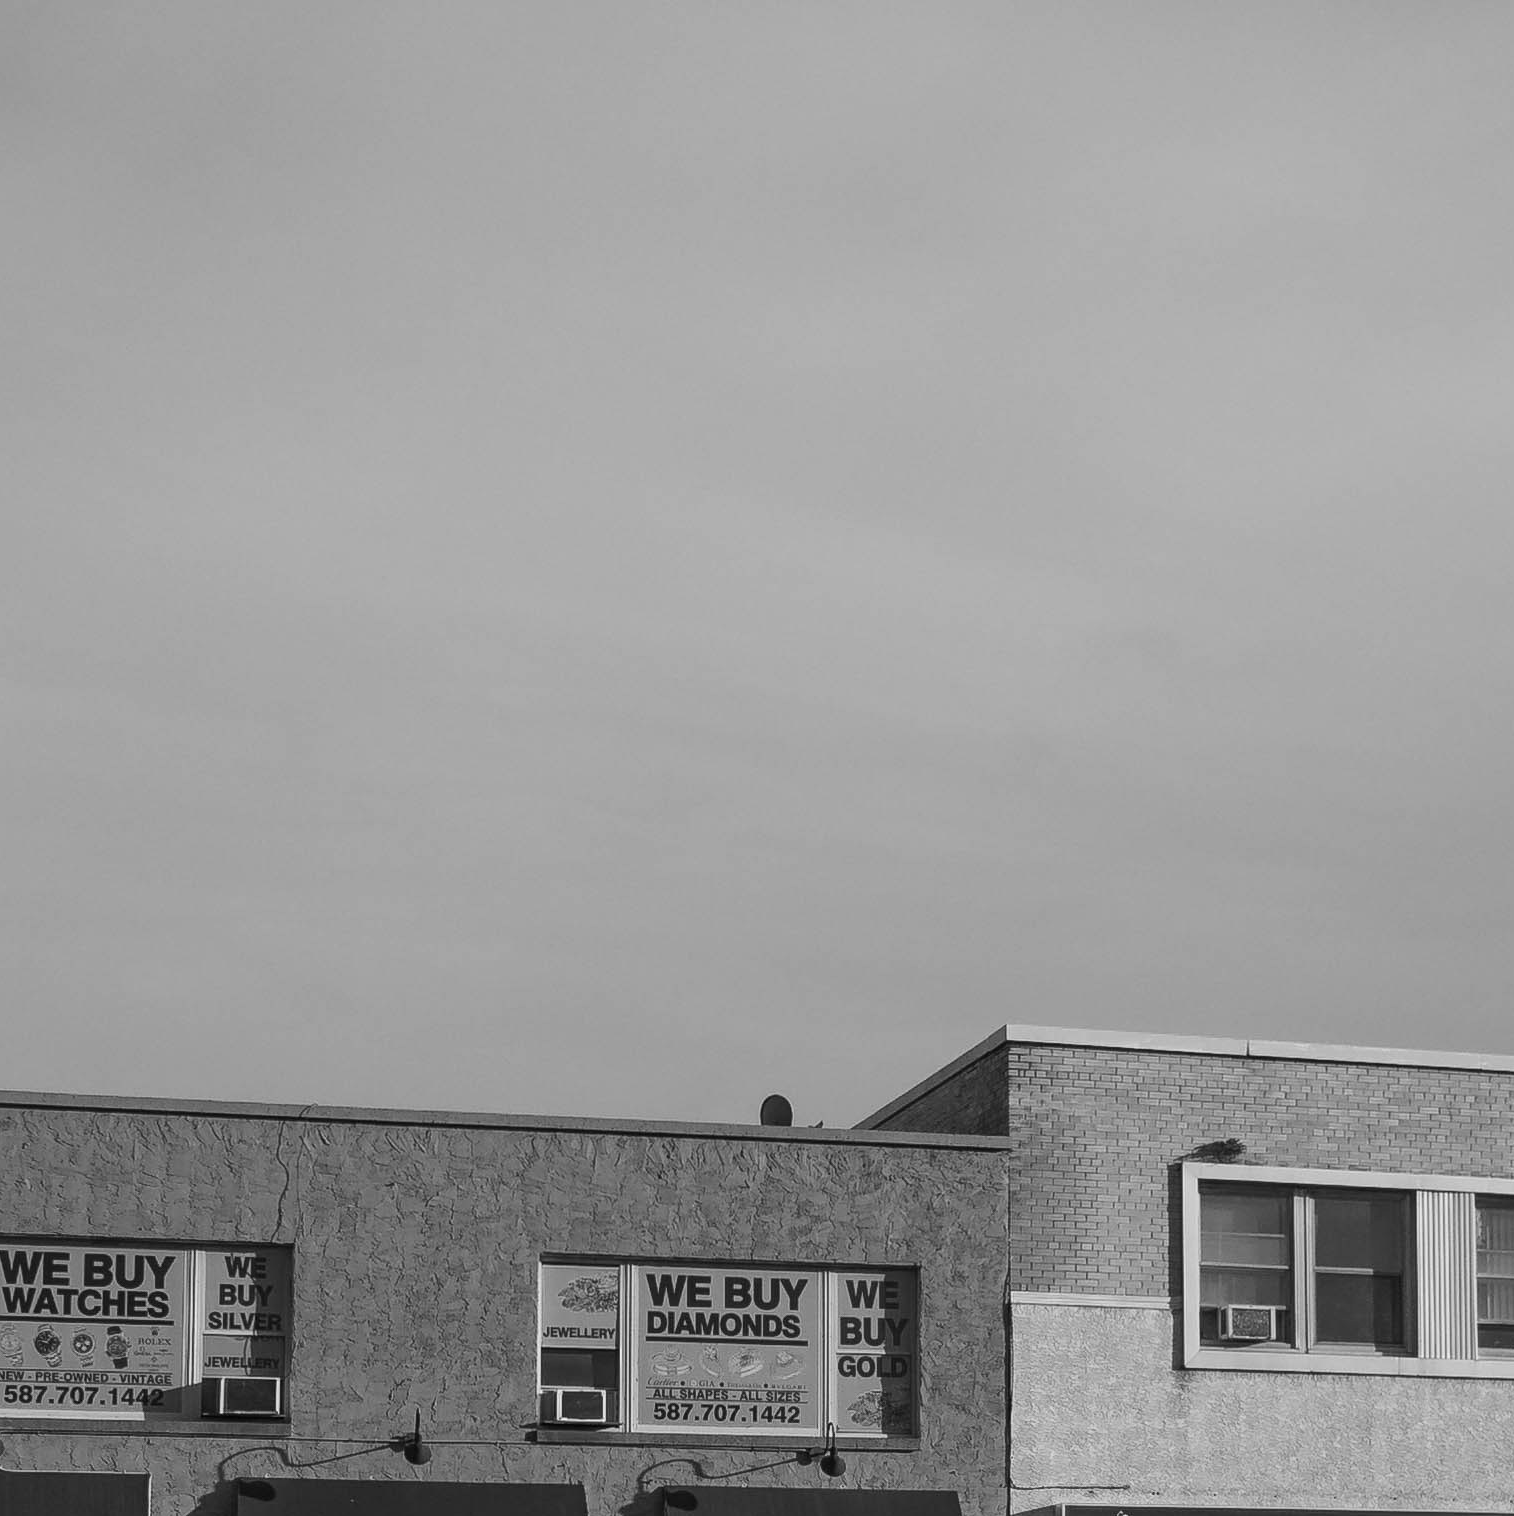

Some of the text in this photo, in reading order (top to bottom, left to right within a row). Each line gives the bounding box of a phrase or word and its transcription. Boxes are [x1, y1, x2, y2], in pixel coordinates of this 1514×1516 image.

[83, 1255, 176, 1290] BUY
[224, 1255, 267, 1279] WE
[2, 1287, 170, 1318] WATCHES
[219, 1283, 273, 1307] BUY
[645, 1274, 808, 1311] WE BUY
[846, 1280, 899, 1309] WE
[208, 1311, 282, 1331] SILVER
[543, 1326, 615, 1339] JEWELLERY
[646, 1311, 802, 1338] DIAMONDS
[840, 1318, 909, 1347] BUY
[204, 1356, 280, 1369] JEWELLERY
[838, 1356, 908, 1378] GOLD
[34, 1372, 109, 1384] PRE-OWNED
[120, 1374, 173, 1385] VINTAGE
[4, 1384, 165, 1406] 587.707.1442
[653, 1388, 676, 1399] ALL
[679, 1389, 728, 1400] SHAPES
[739, 1390, 762, 1401] ALL
[765, 1391, 801, 1402] SIZES
[653, 1402, 801, 1424] 587.707.1442
